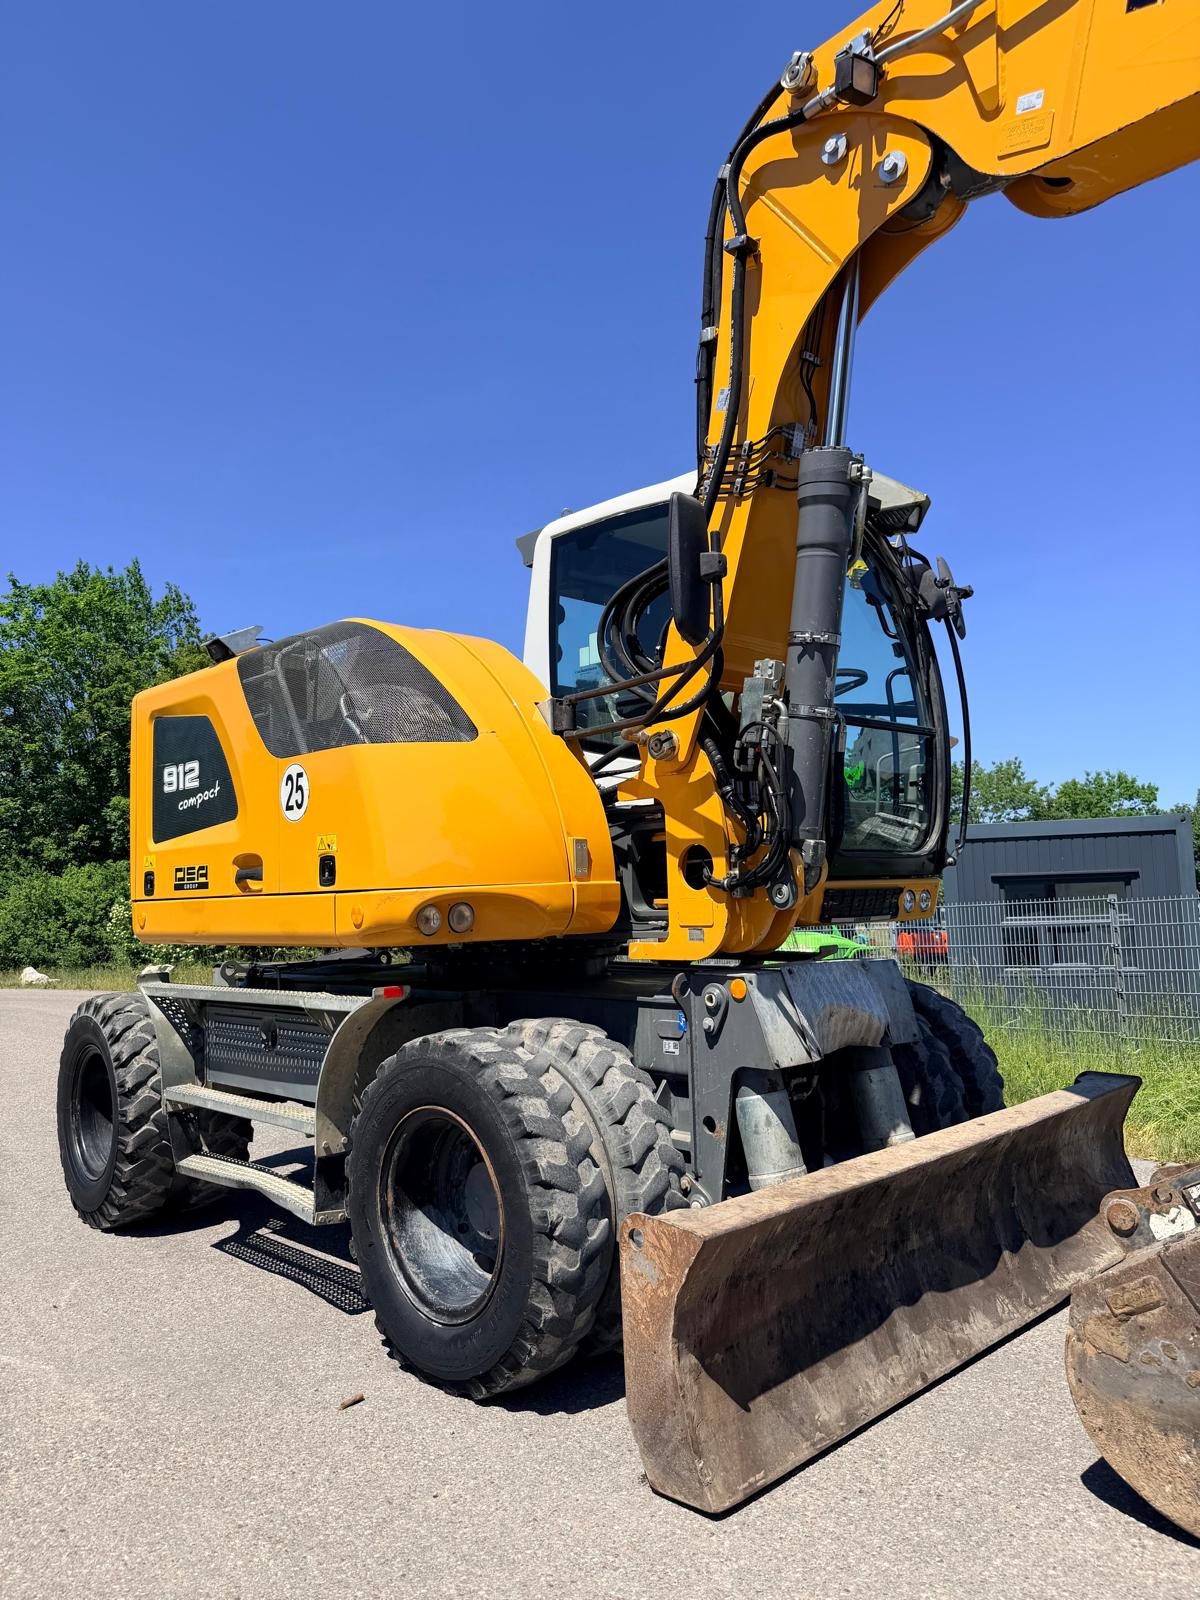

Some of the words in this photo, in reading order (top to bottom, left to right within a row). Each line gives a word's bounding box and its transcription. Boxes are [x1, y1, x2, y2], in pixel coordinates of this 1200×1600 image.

[163, 759, 200, 794] 912
[284, 772, 304, 812] 25
[177, 780, 221, 811] compact
